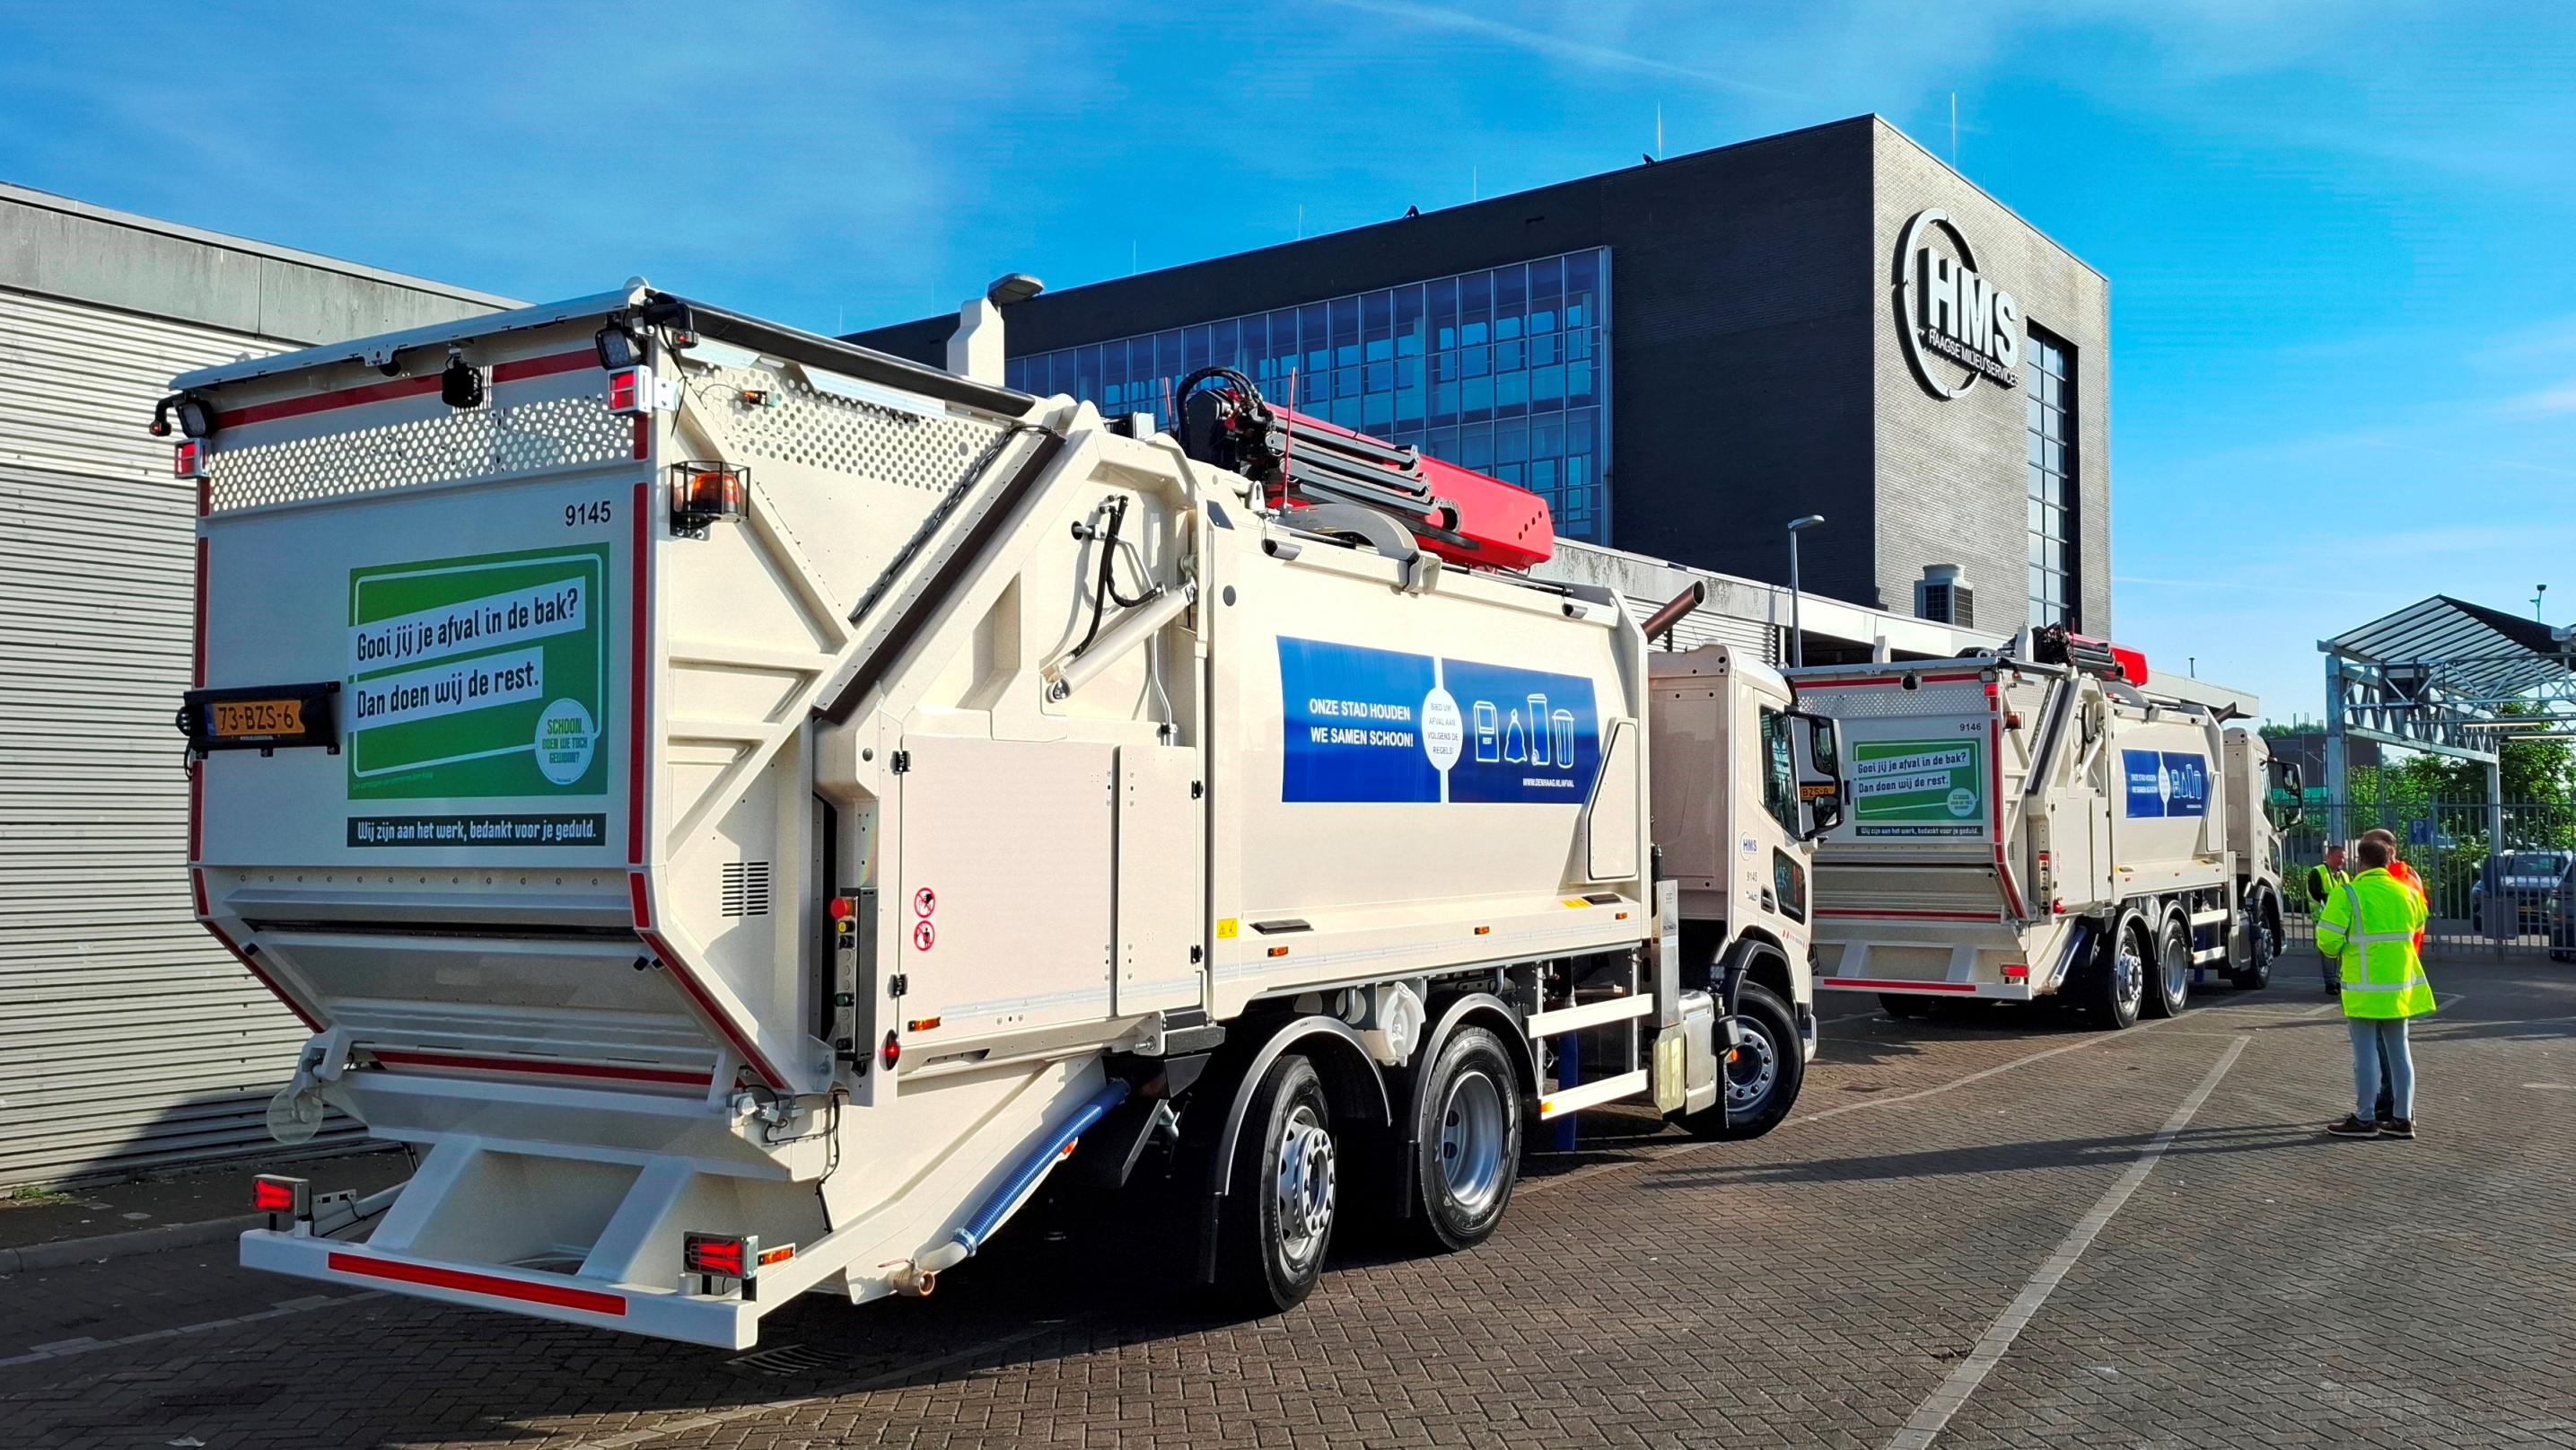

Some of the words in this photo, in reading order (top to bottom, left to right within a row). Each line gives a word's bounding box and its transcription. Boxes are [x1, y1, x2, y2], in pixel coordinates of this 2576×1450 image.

[1928, 246, 2019, 368] HMS
[1929, 329, 1961, 358] HAAGSE
[1985, 356, 2020, 387] SERVICES
[565, 500, 612, 528] 9145
[357, 628, 391, 662] Gooi
[394, 623, 413, 659] jij
[416, 621, 433, 655] je
[437, 610, 480, 648] afval
[485, 607, 502, 635] in
[507, 601, 529, 630] de
[534, 587, 579, 626] bak?
[357, 690, 386, 719] Dan
[390, 684, 429, 713] doen
[434, 672, 462, 706] wij
[469, 669, 489, 698] de
[495, 661, 539, 693] rest.
[217, 704, 294, 731] 73-BZS-6
[1309, 698, 1339, 716] ONZE
[1341, 700, 1368, 717] STAD
[1370, 703, 1411, 721] HOUDEN
[547, 717, 584, 735] SCHOON,
[1310, 726, 1328, 743] WE
[1330, 727, 1368, 745] SAMEN
[1370, 730, 1414, 747] SCHOON!
[1959, 723, 1982, 732] 9146
[1858, 762, 1876, 774] Gooi
[1878, 760, 1887, 773] jij
[1888, 760, 1897, 772] je
[1899, 755, 1920, 770] afval
[1922, 757, 1931, 767] in
[1932, 754, 1943, 766] de
[1946, 751, 1967, 765] bak?
[1858, 783, 1874, 793] Dan
[1876, 781, 1897, 791] doen
[1898, 778, 1913, 789] wij
[1914, 777, 1925, 787] de
[1927, 775, 1949, 786] rest.
[357, 821, 375, 842] Wij
[376, 822, 395, 842] zijn
[397, 823, 415, 839] aan
[416, 821, 434, 839] het
[436, 821, 467, 842] werk,
[469, 820, 513, 839] bedankt
[514, 823, 540, 839] voor
[541, 819, 553, 841] je
[556, 819, 597, 841] geduld.
[1743, 839, 1757, 852] HMS
